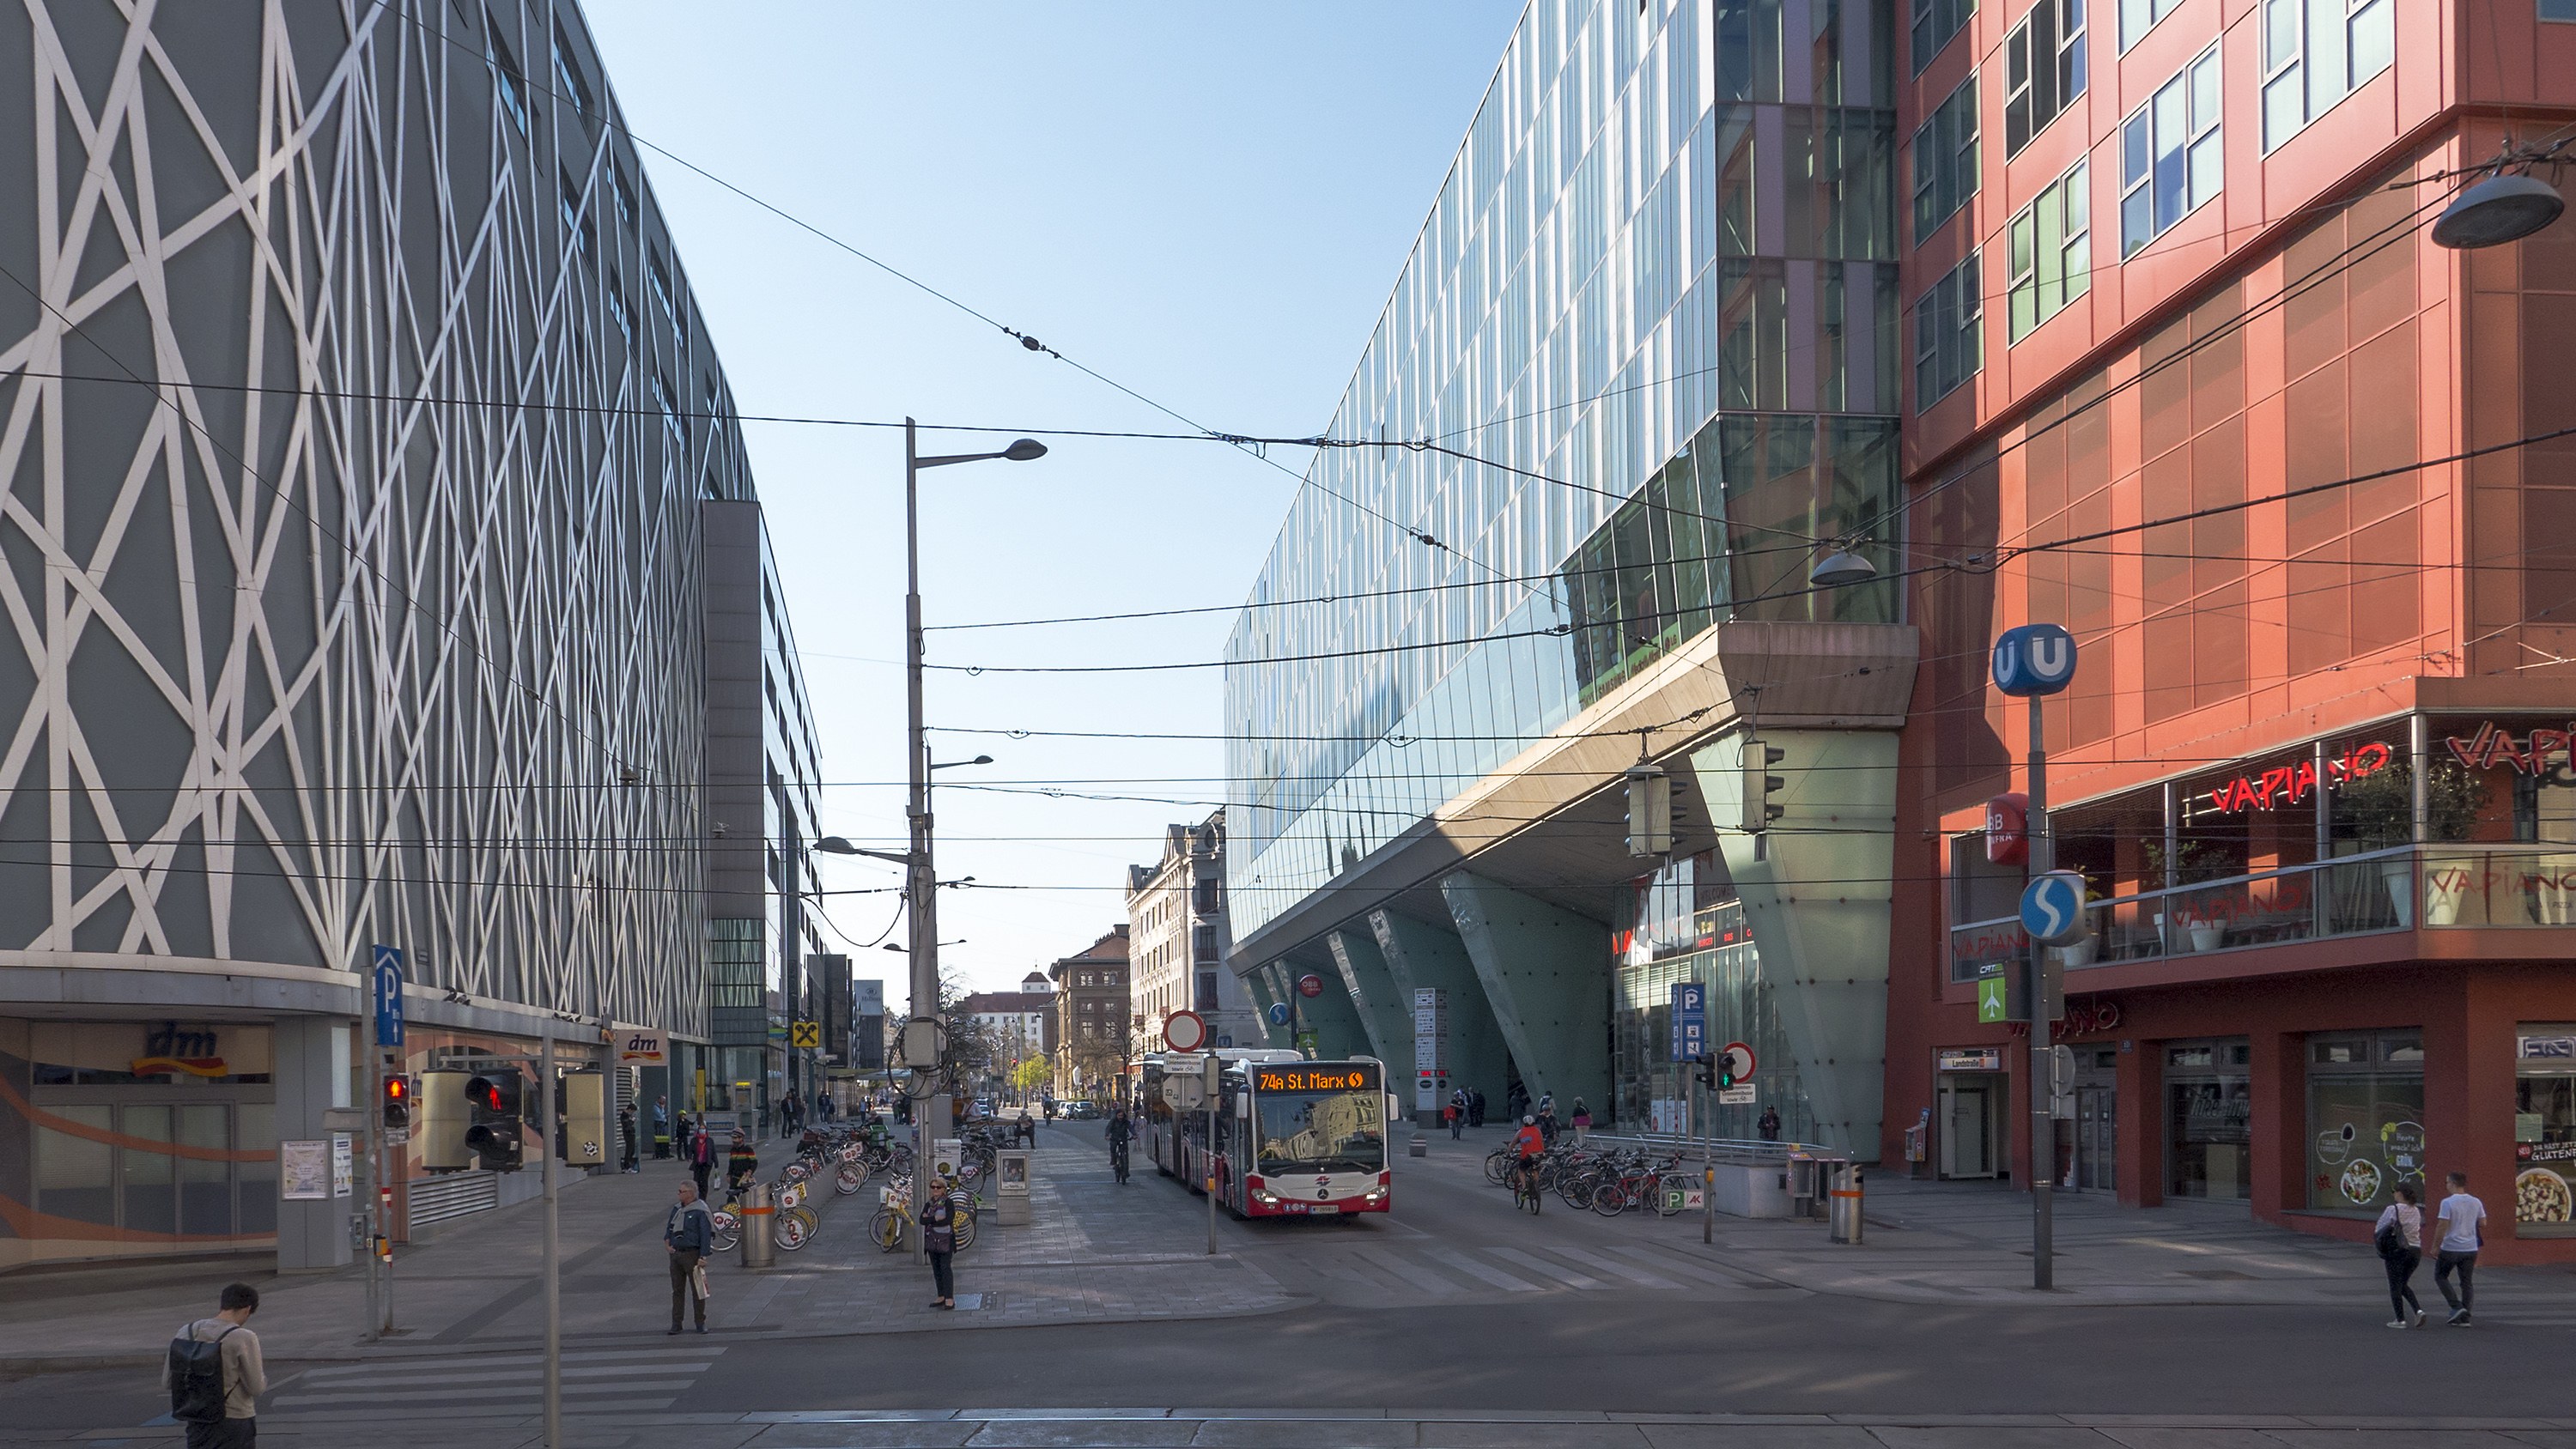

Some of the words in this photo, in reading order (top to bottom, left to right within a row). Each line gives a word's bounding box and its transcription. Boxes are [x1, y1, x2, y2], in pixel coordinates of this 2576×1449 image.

[1996, 640, 2014, 683] U
[2032, 637, 2067, 676] U
[2212, 742, 2394, 813] VAPIANO
[2172, 882, 2303, 930] VAPIANO
[1980, 964, 1996, 974] CAT
[385, 967, 397, 1013] P
[1685, 993, 1698, 1009] P
[148, 1022, 216, 1057] dm
[629, 1034, 658, 1051] dm
[1261, 1074, 1283, 1090] 74A
[1288, 1074, 1306, 1089] St.
[1309, 1072, 1344, 1088] Marx
[2518, 1146, 2530, 1156] NEU
[1668, 1192, 1680, 1208] P
[1689, 1194, 1701, 1204] AK
